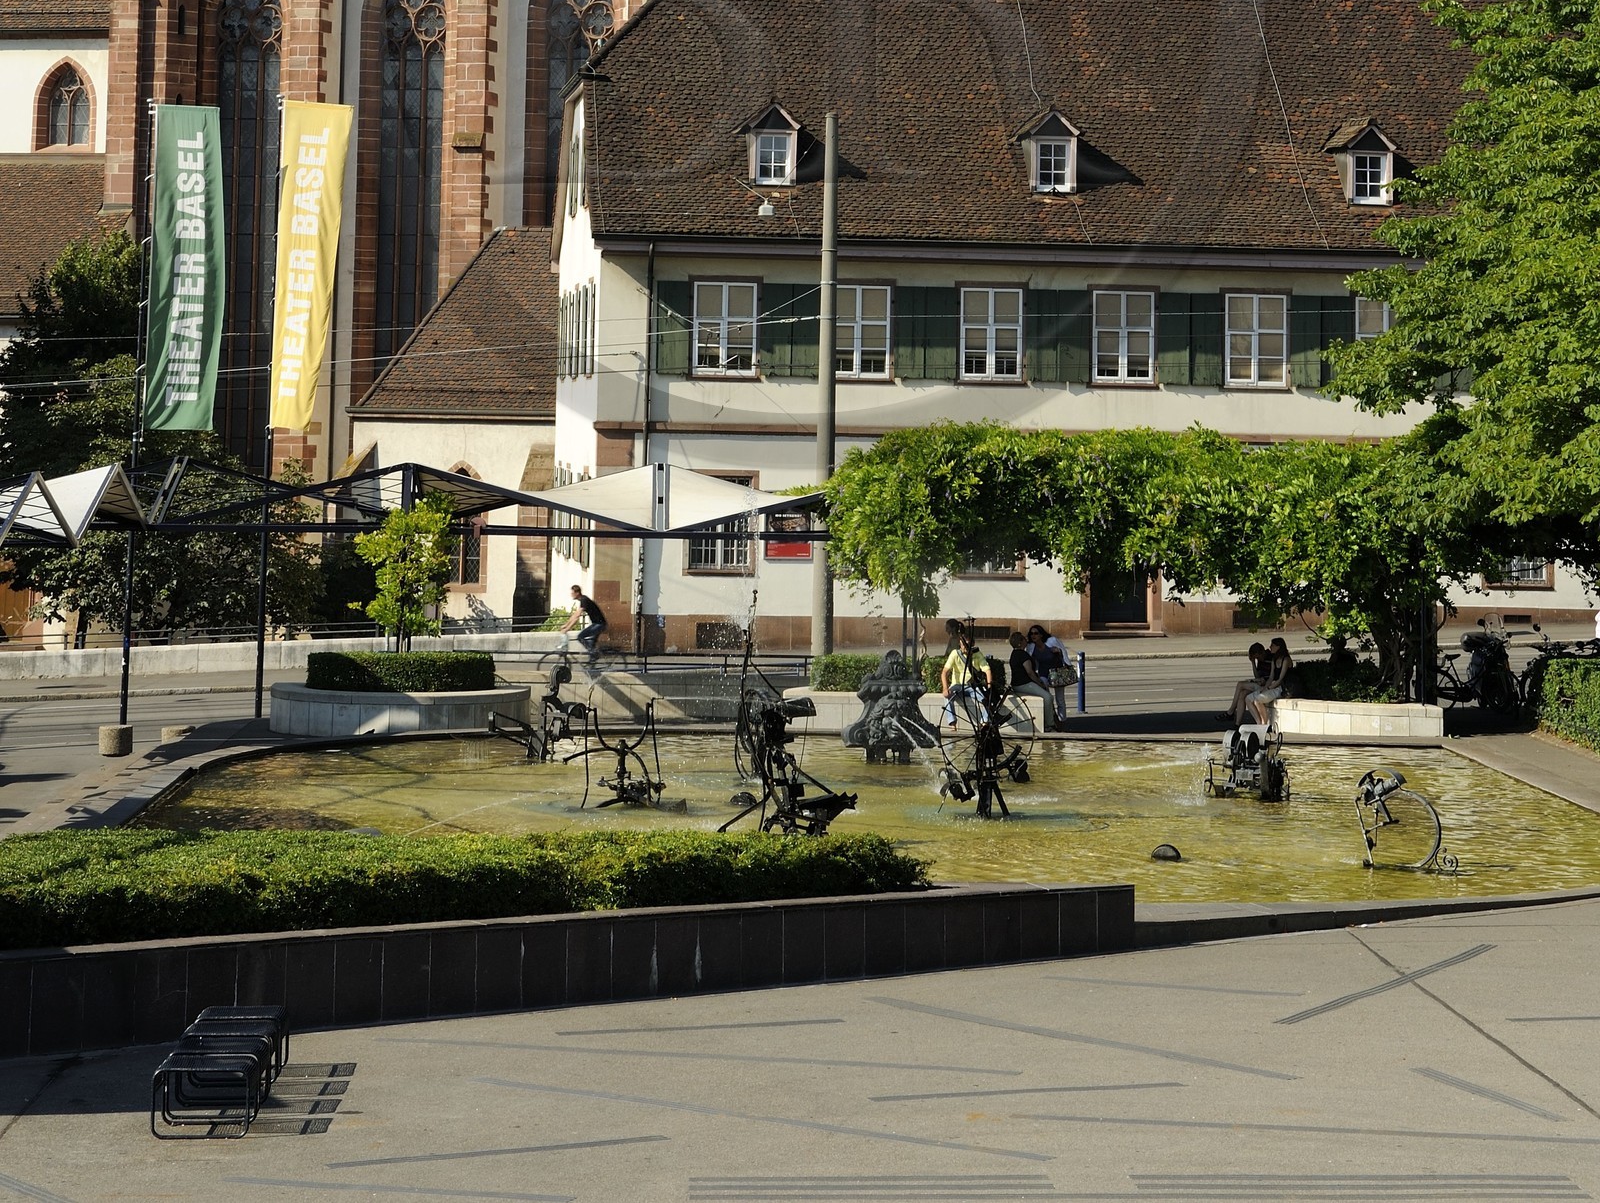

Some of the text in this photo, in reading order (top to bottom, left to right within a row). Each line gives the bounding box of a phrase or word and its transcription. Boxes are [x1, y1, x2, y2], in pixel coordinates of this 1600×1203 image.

[165, 131, 206, 406] THEATER BASEL
[278, 127, 330, 398] THEATER BASEL
